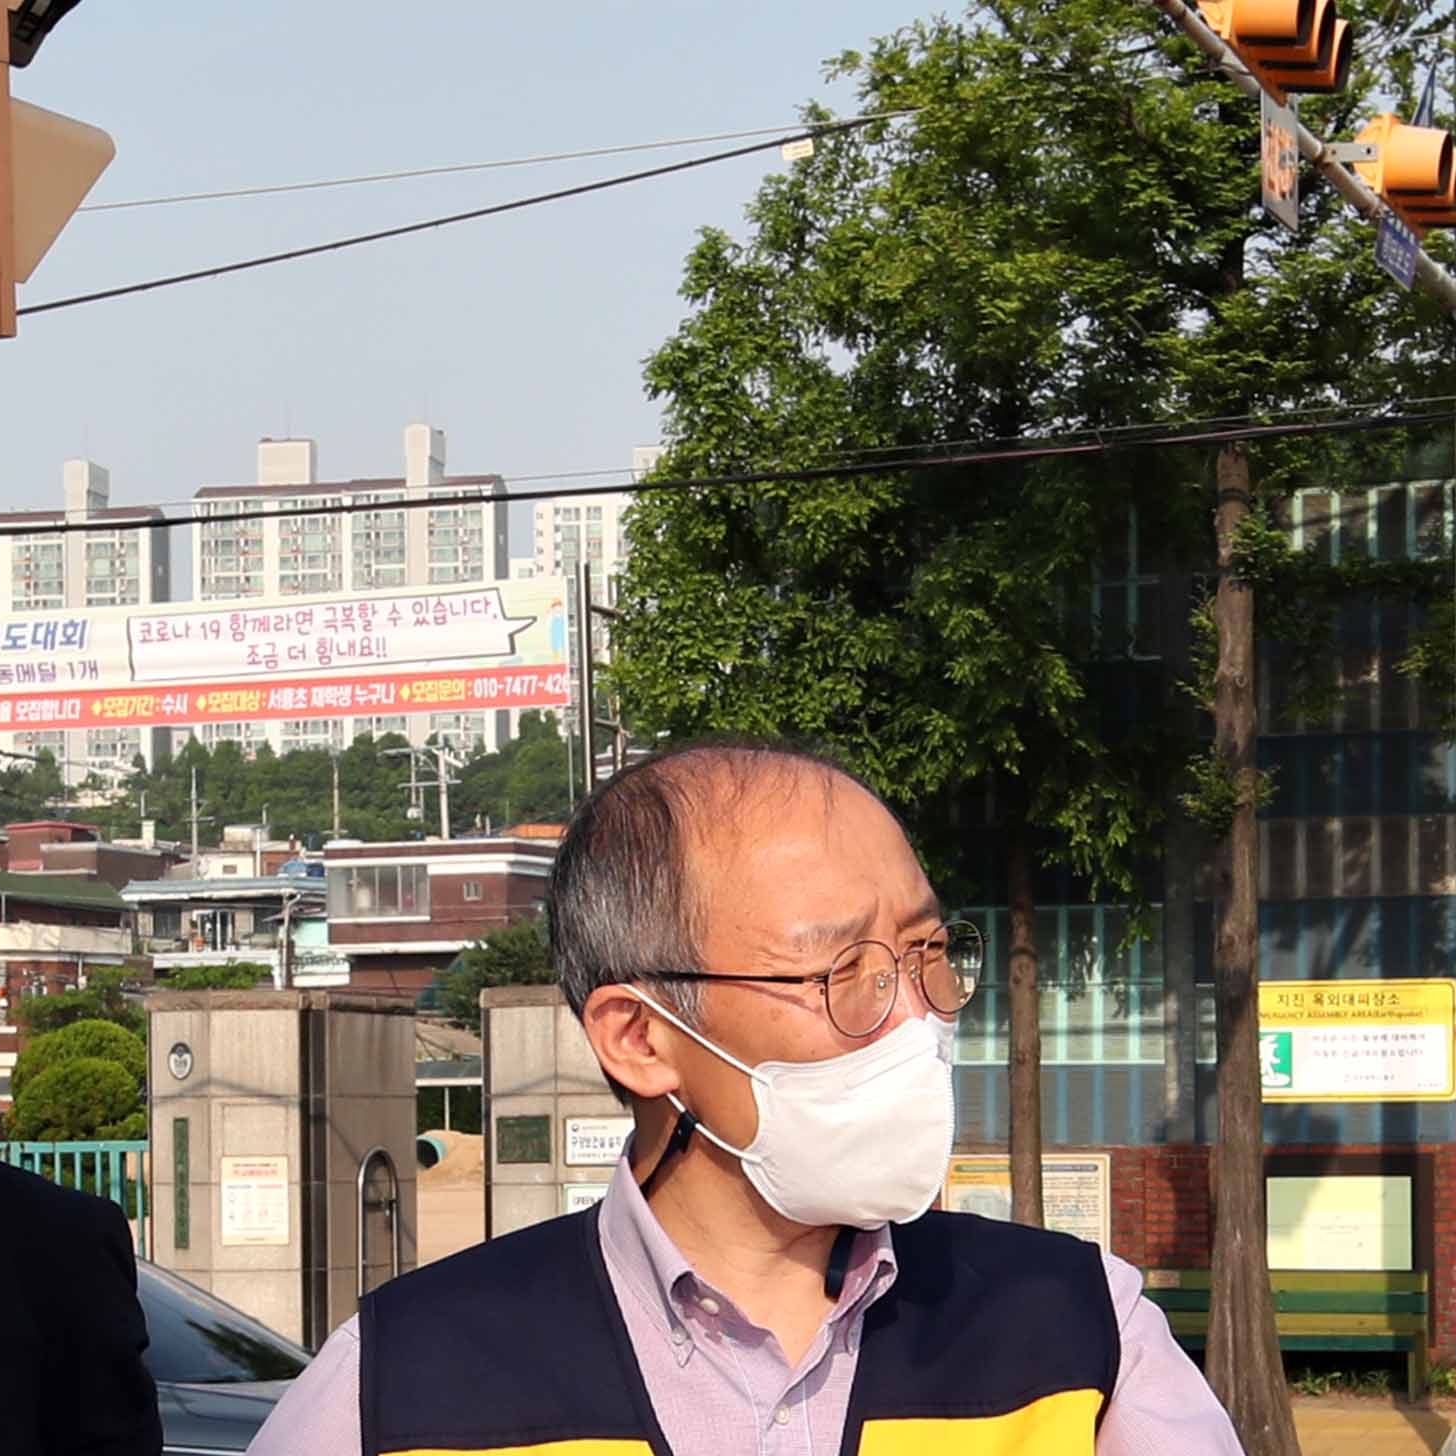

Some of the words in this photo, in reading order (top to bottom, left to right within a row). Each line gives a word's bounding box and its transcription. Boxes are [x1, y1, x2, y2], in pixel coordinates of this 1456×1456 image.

[139, 620, 191, 644] 코로나
[200, 620, 221, 641] 19
[230, 609, 314, 642] 함께라면
[323, 601, 378, 633] 극복할
[387, 602, 404, 627] 수
[411, 596, 497, 627] 있습니다.
[247, 642, 279, 670] 조금
[288, 644, 306, 661] 더
[316, 636, 387, 666] 힘내요!!
[68, 659, 99, 681] 1개
[355, 682, 395, 705] 누구나
[1278, 993, 1305, 1007] 지진
